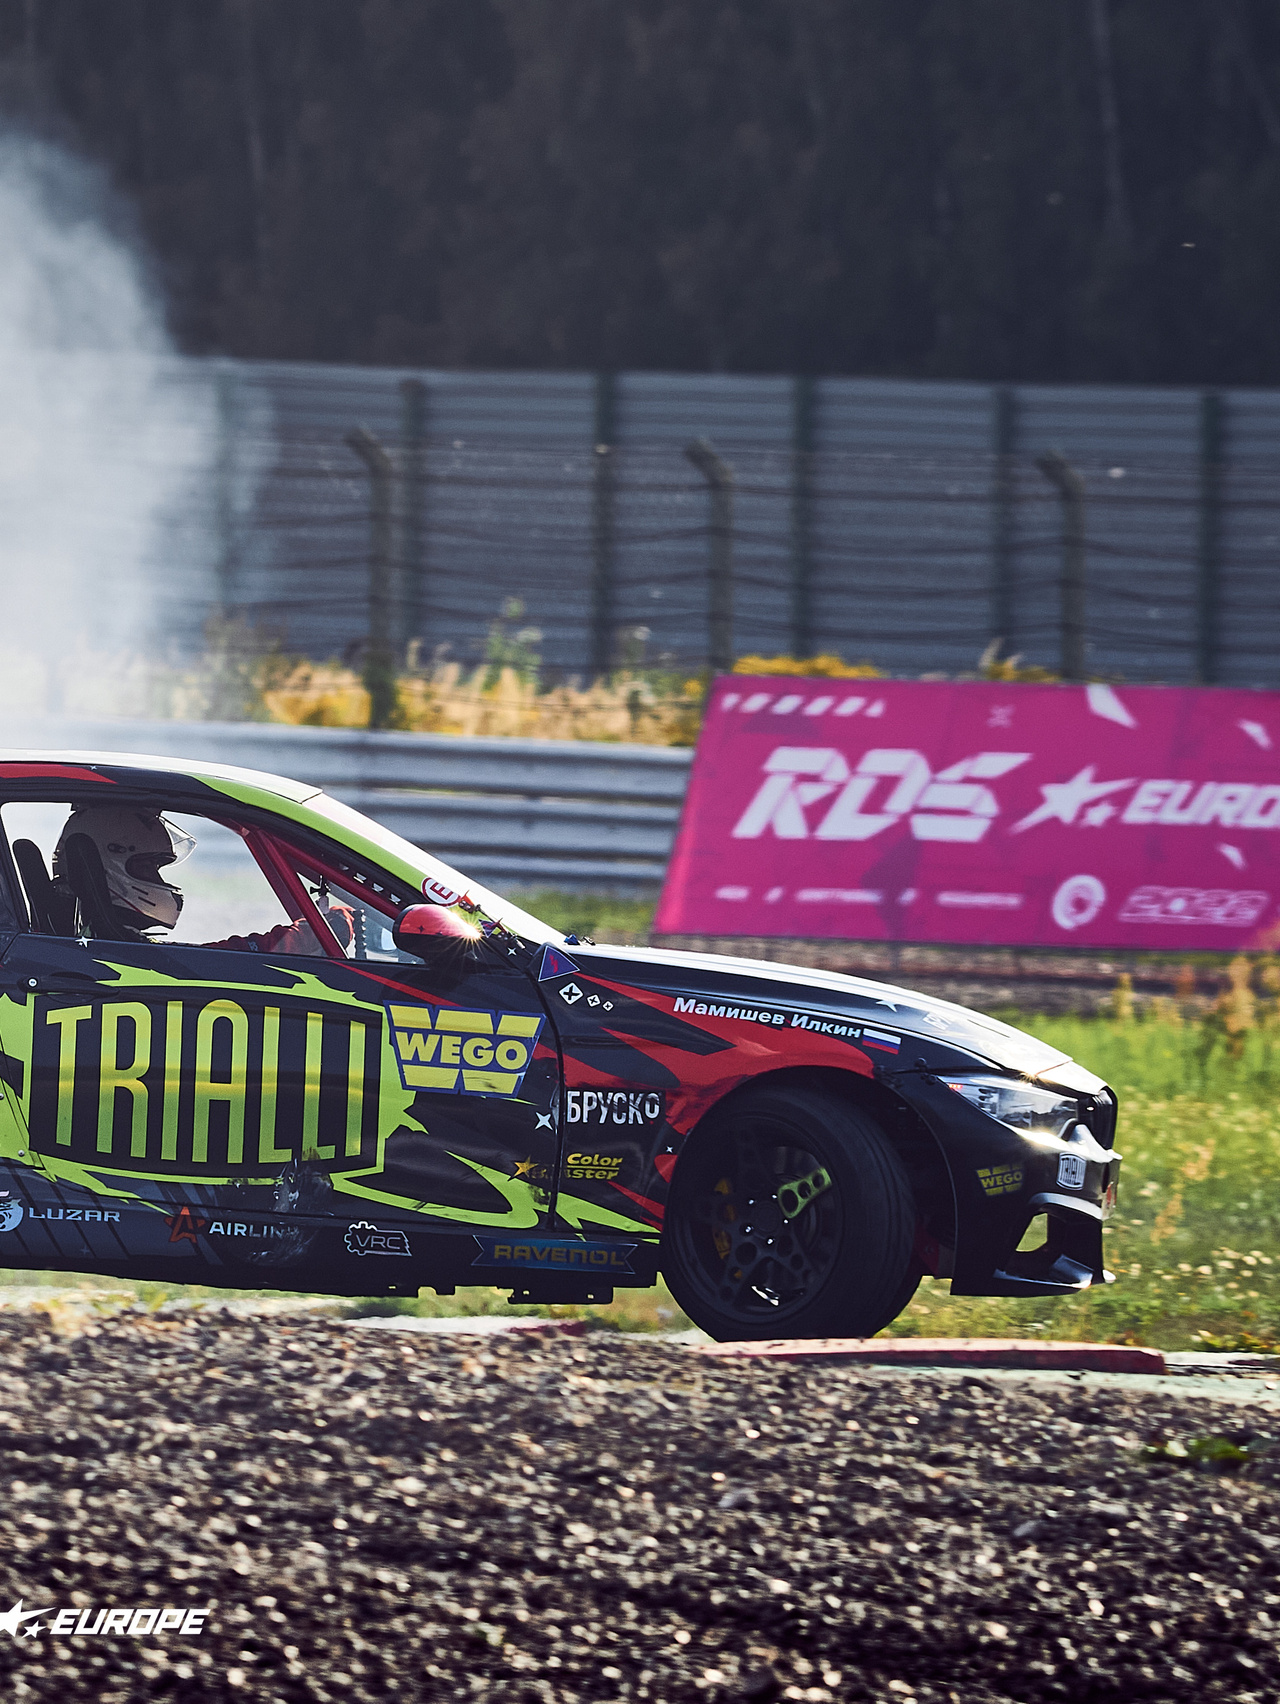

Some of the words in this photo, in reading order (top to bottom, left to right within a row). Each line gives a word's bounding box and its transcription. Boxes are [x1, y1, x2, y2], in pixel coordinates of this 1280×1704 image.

[732, 745, 1033, 842] RDS
[673, 997, 785, 1026] Мамишев
[791, 1014, 862, 1039] Илкин
[394, 1030, 529, 1071] WEGO
[46, 999, 367, 1164] TRIALLI
[566, 1090, 661, 1125] БРУСКО
[566, 1152, 624, 1167] Color
[980, 1171, 1024, 1189] WEGO
[28, 1206, 121, 1223] LUZAR
[355, 1234, 402, 1250] VRC
[493, 1244, 625, 1266] RAVENOL
